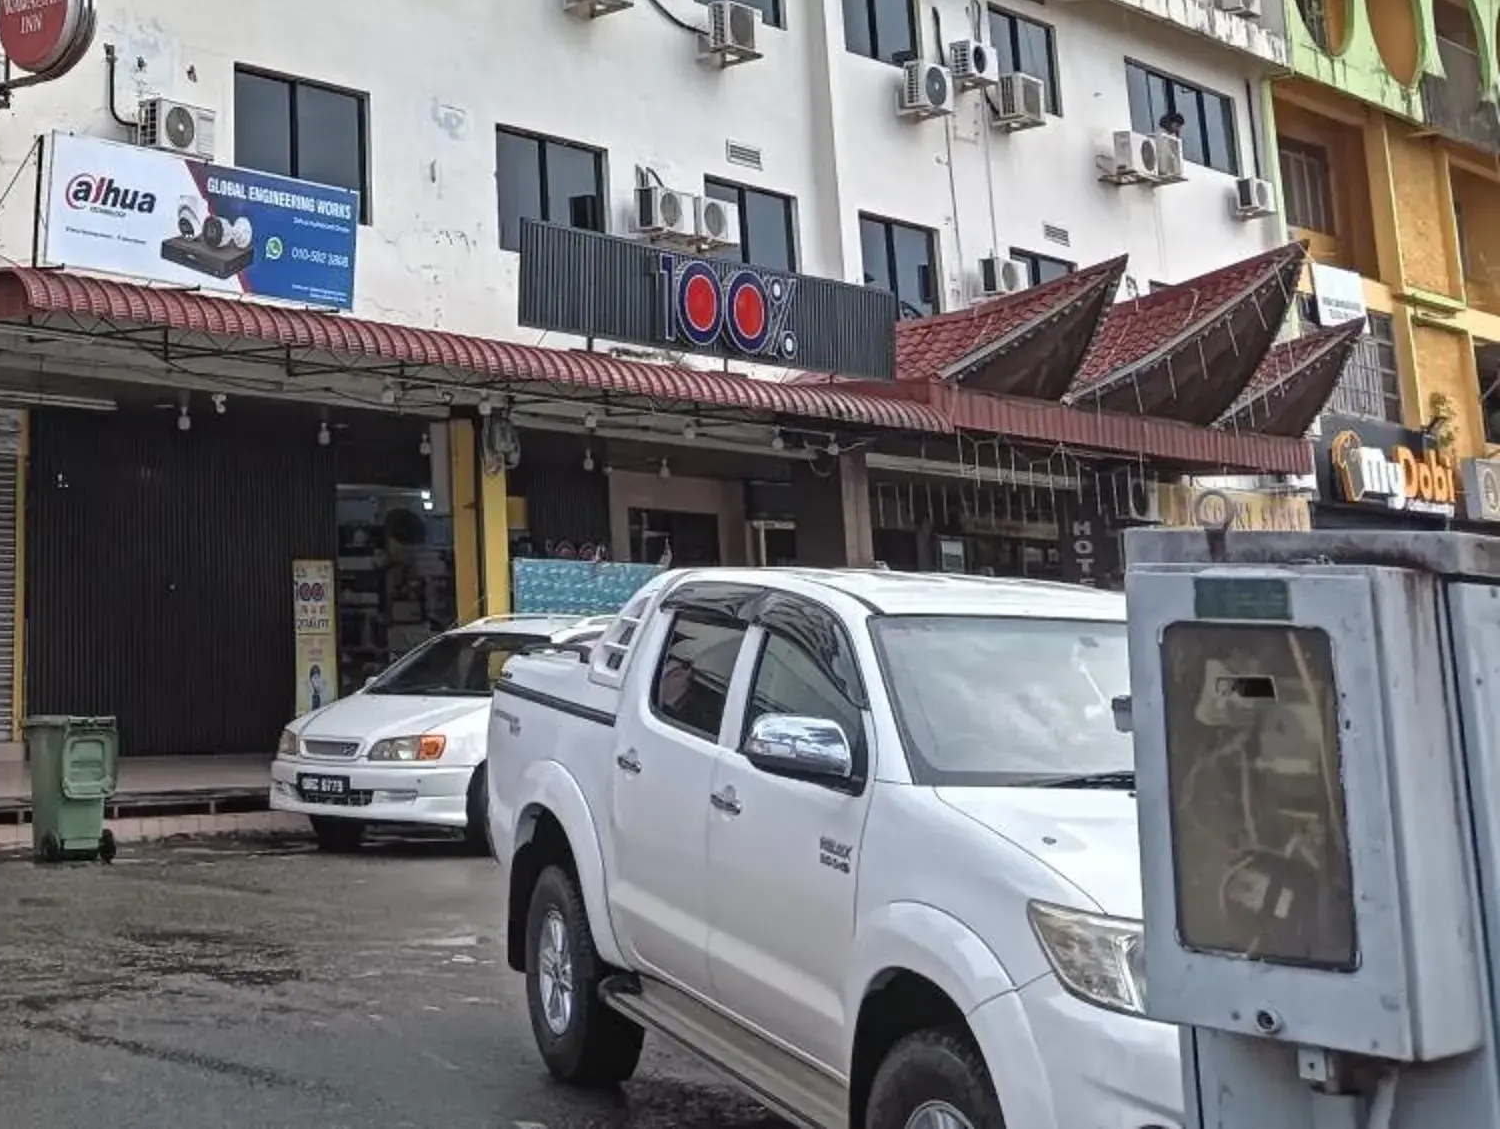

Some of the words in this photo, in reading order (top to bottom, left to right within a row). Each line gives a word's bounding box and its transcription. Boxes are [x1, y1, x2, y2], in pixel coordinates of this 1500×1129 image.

[20, 11, 42, 34] INN
[207, 177, 247, 200] GLOBAL
[248, 186, 315, 213] ENGINEERING
[316, 200, 351, 220] WORKS
[659, 253, 799, 359] 100%
